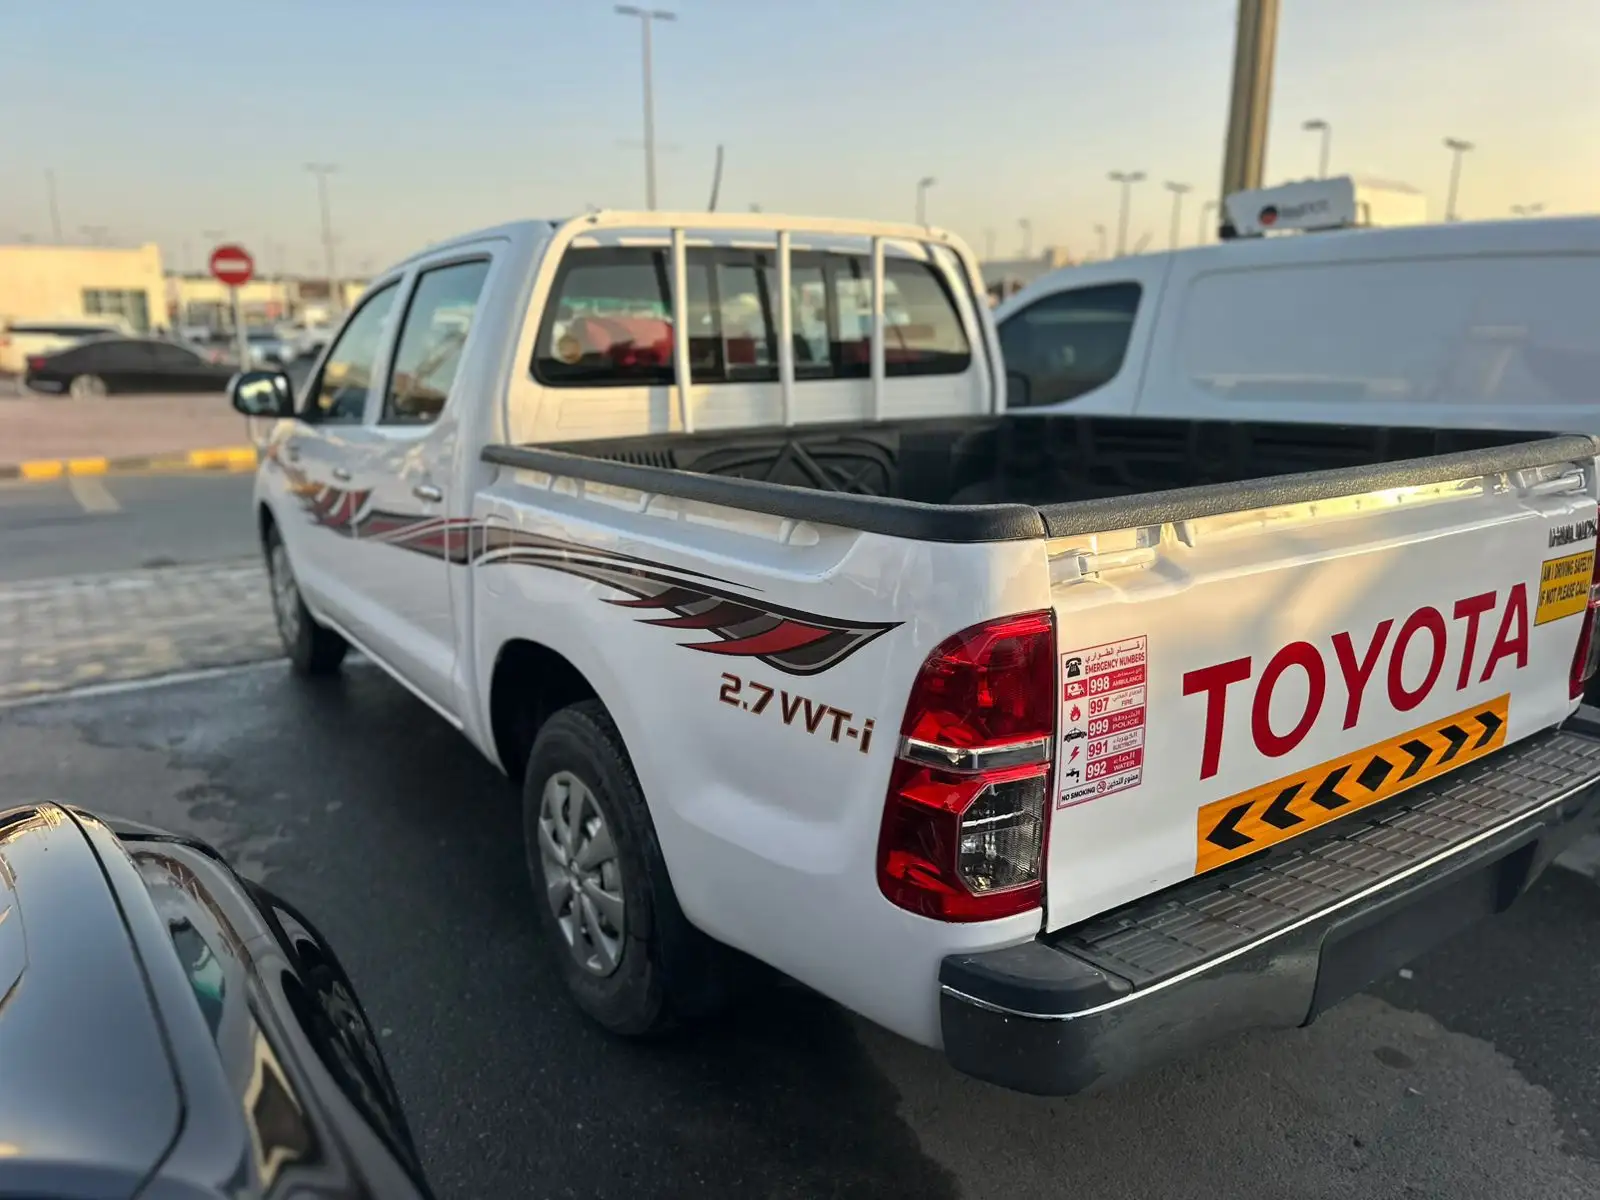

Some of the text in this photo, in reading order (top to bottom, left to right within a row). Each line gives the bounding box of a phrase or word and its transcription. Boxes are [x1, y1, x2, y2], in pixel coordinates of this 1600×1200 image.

[1085, 652, 1145, 675] EMERGENCY NUMBERS
[1090, 674, 1143, 693] 998 AMBULANCE
[1183, 582, 1529, 781] TOYOTA
[718, 672, 877, 754] 2.7 VVT-i
[1090, 697, 1133, 714] 997 FIRE
[1089, 718, 1140, 737] 999 POLICE
[1088, 740, 1108, 757] 991
[1087, 760, 1135, 778] 992 WATER
[1061, 786, 1096, 801] NO SMOKING
